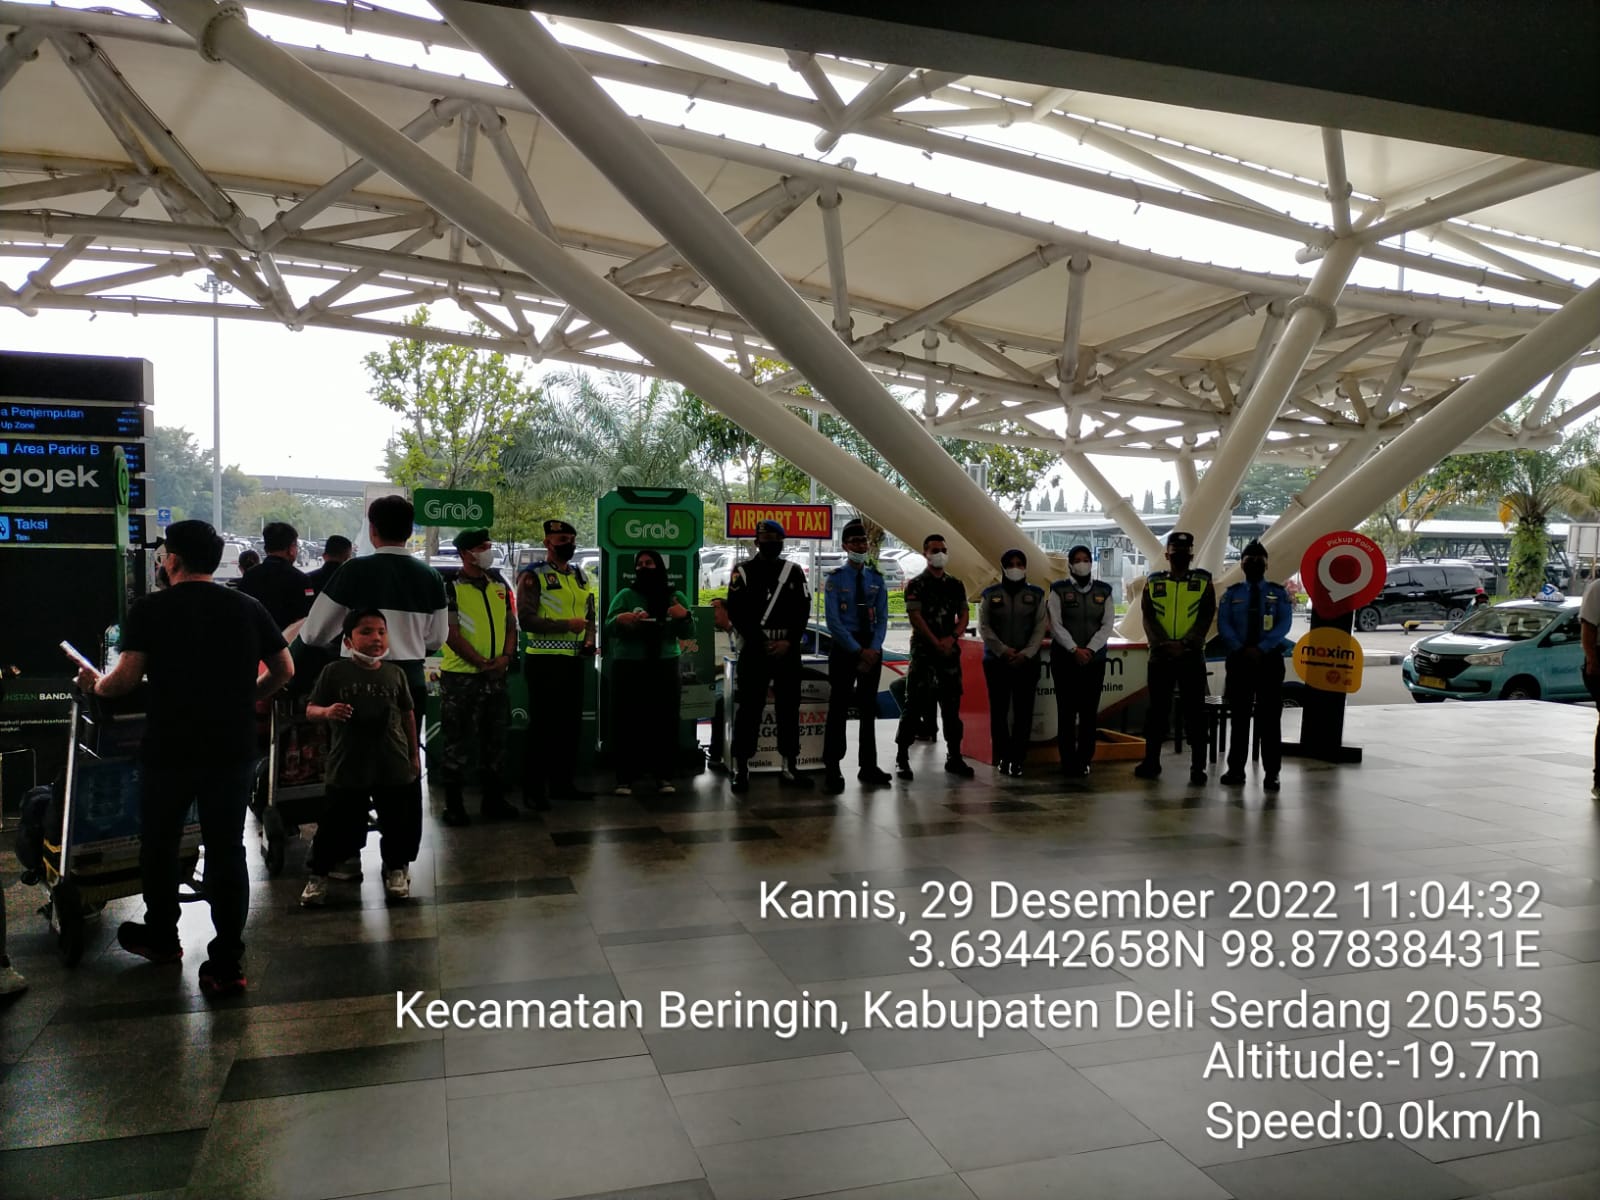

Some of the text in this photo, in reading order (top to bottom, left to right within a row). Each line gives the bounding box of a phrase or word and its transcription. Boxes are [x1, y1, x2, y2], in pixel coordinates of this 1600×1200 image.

[11, 408, 84, 420] Penjemputan
[14, 422, 35, 430] Zone
[13, 444, 100, 456] Area Parkir B
[0, 465, 99, 494] gojek
[424, 498, 483, 520] Grab
[15, 518, 48, 530] Taksi
[796, 511, 827, 532] TAXI
[625, 519, 680, 539] Grab
[1326, 536, 1353, 547] Pickup
[1301, 645, 1355, 660] maxim
